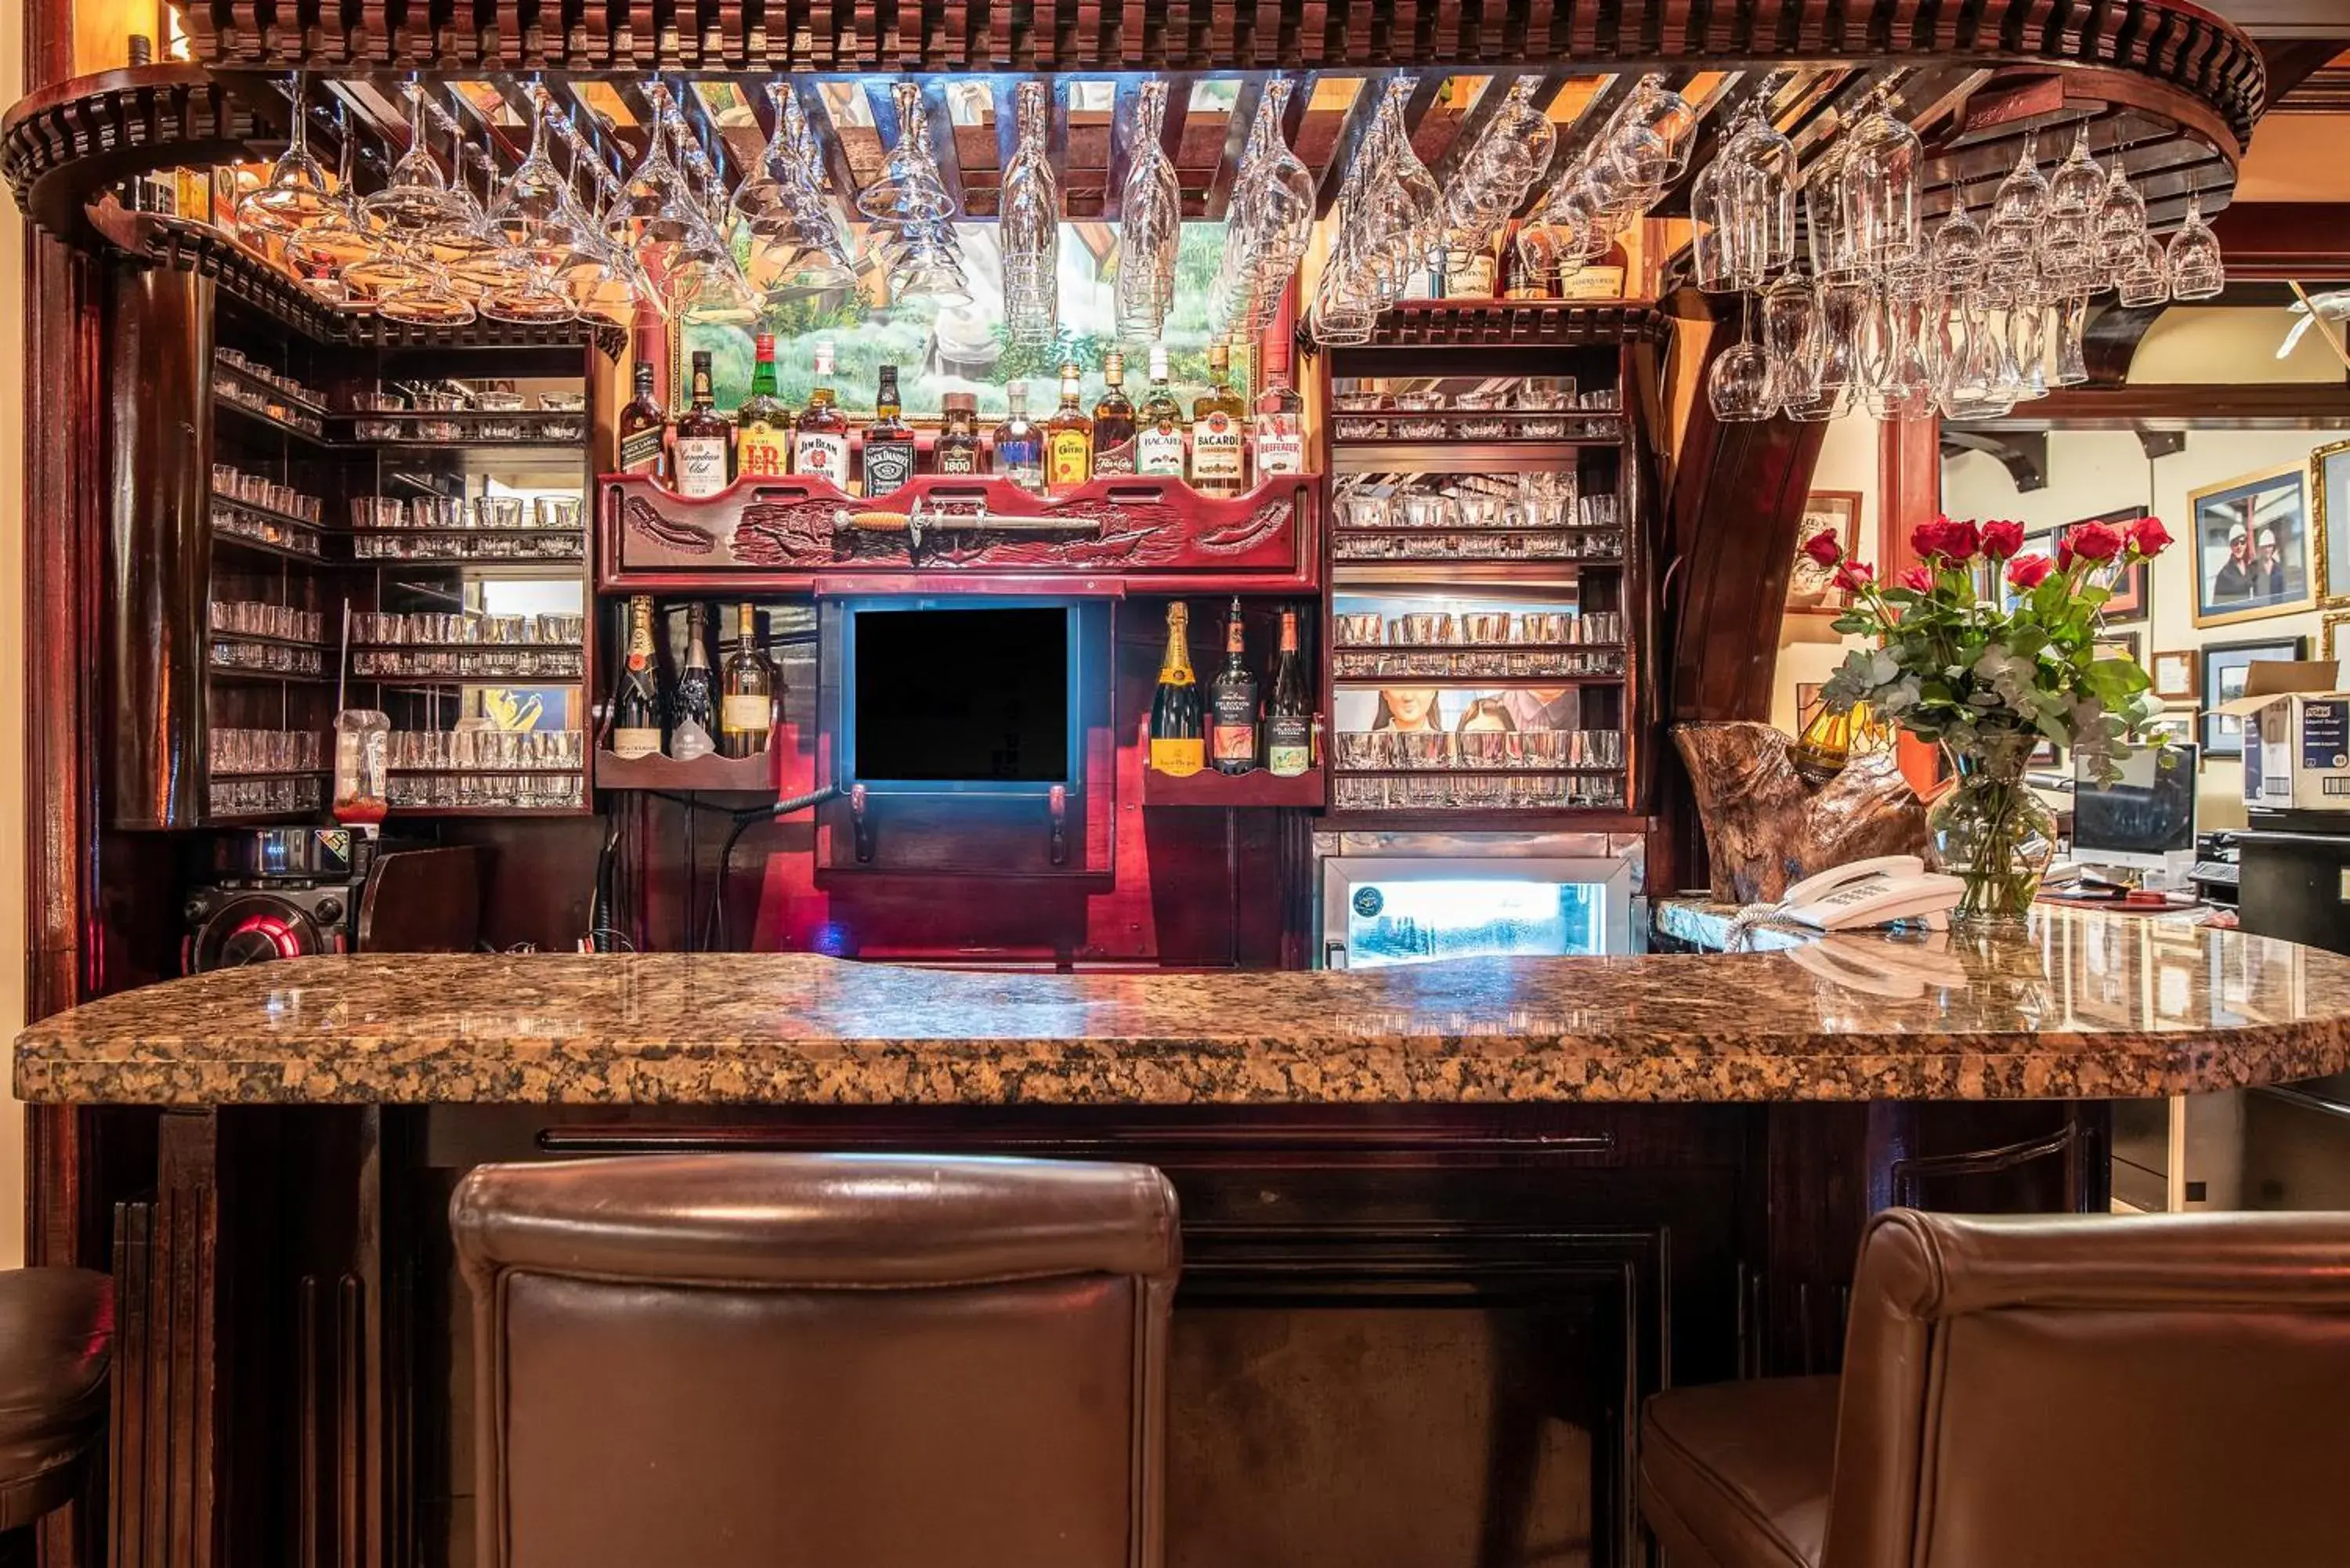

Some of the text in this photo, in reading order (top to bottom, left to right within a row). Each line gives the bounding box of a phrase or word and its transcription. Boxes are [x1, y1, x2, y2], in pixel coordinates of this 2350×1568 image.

[800, 439, 837, 456] JIM BEAM
[1260, 443, 1300, 453] BEEFEATER
[867, 453, 883, 466] JACK
[944, 461, 971, 472] 1800
